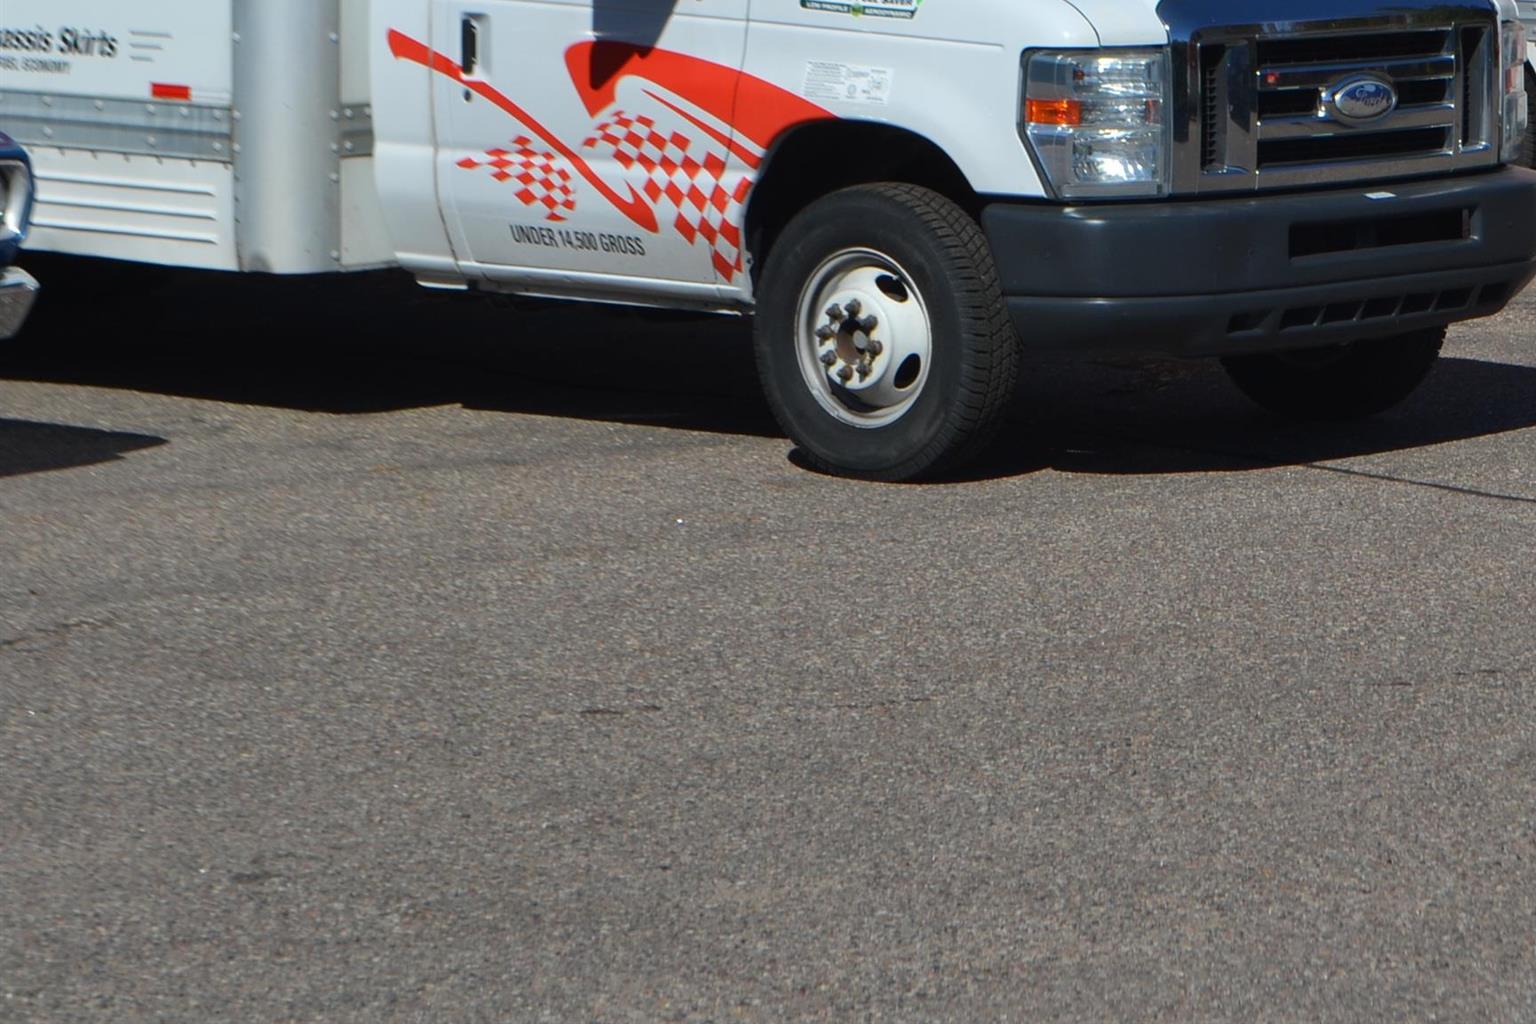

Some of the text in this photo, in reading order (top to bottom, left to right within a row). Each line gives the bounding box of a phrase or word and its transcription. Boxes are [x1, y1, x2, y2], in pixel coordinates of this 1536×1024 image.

[57, 25, 119, 58] Skirts
[509, 224, 647, 257] UNDER 14,500 GROSS
